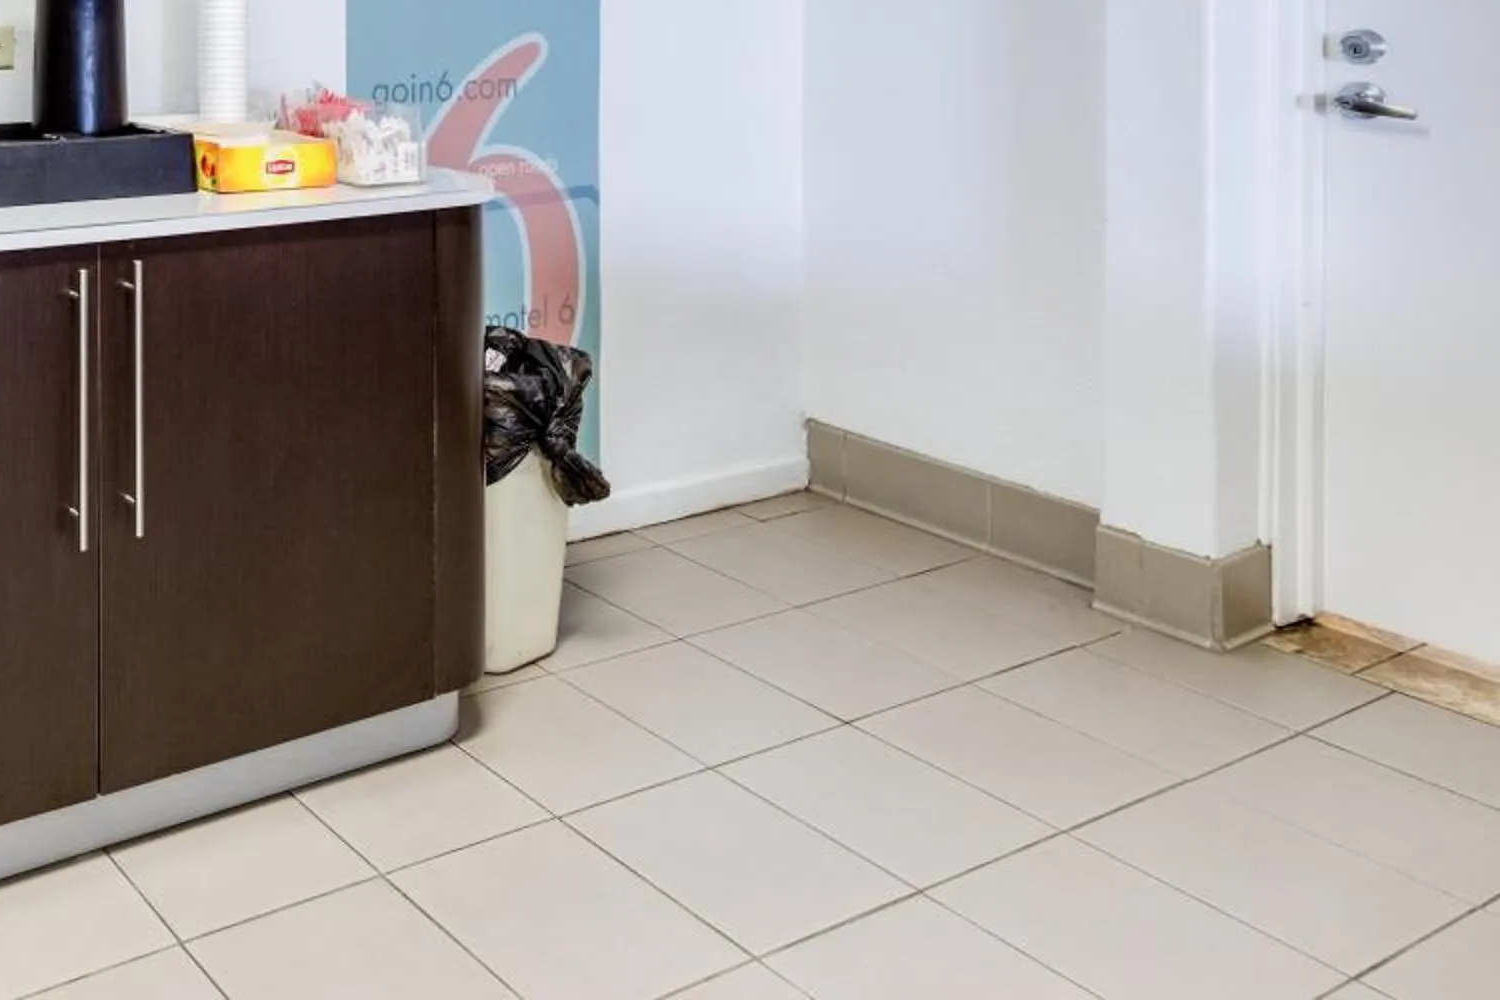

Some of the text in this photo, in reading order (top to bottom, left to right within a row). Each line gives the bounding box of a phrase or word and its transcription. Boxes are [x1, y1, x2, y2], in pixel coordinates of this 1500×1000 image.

[372, 70, 518, 106] goin6.com
[485, 292, 575, 329] motel 6
